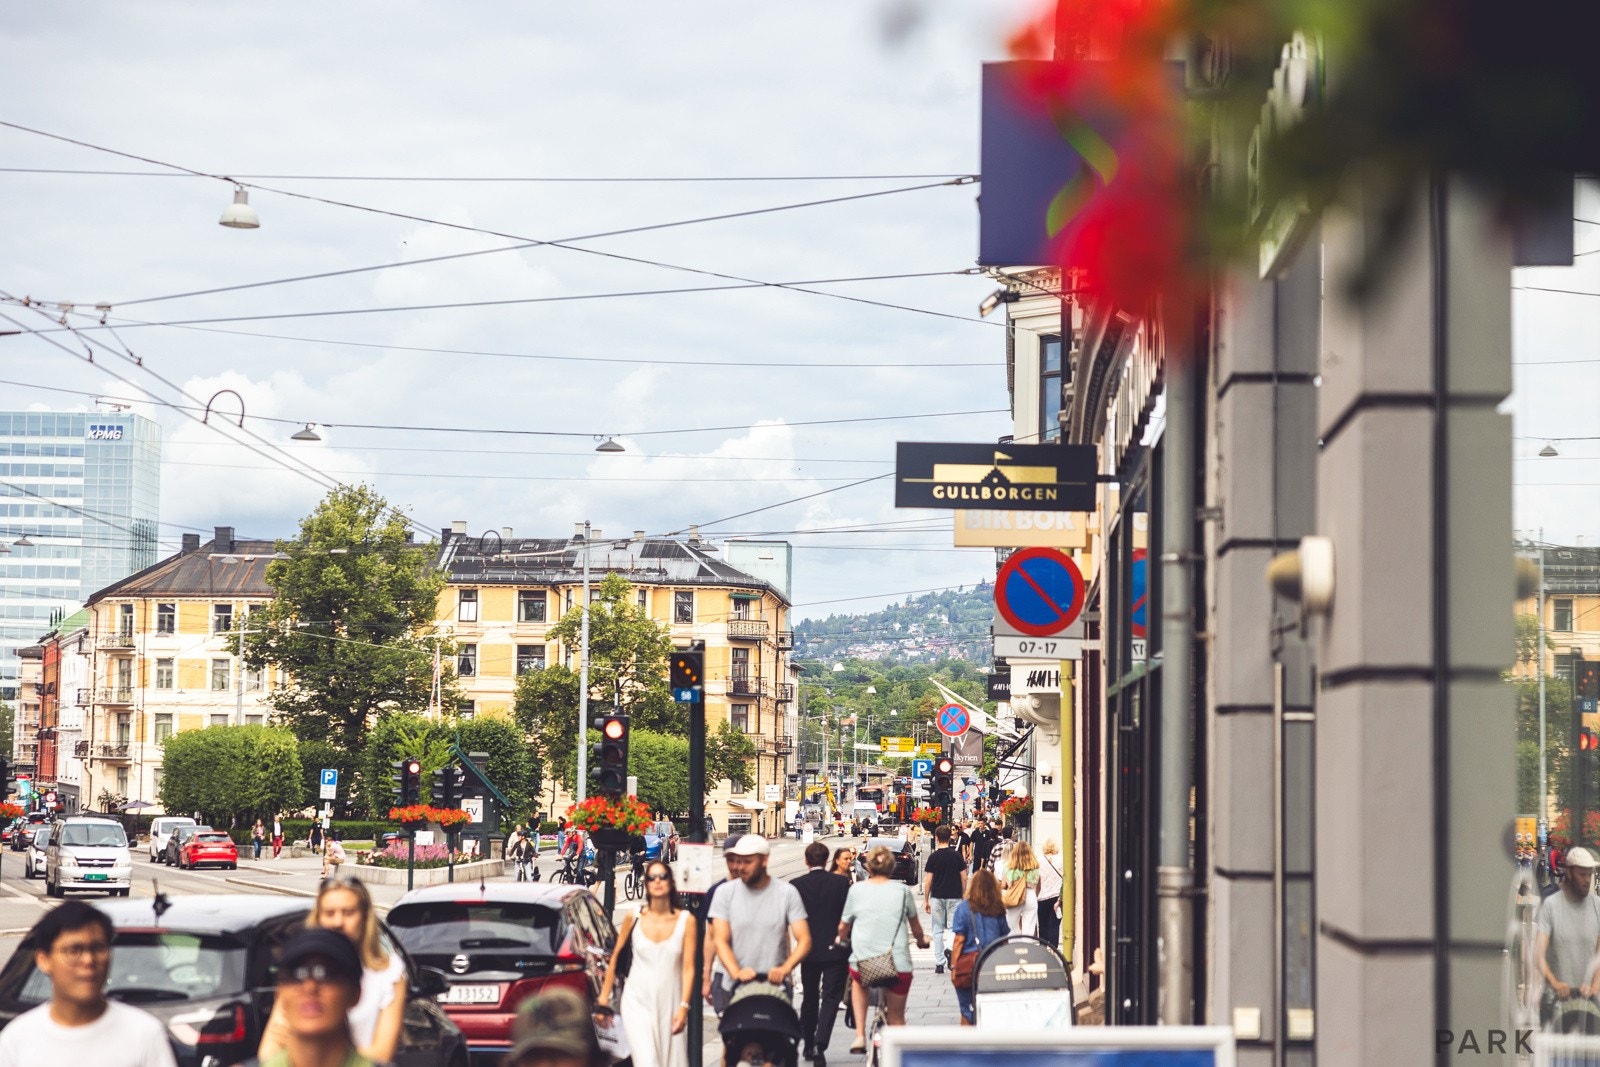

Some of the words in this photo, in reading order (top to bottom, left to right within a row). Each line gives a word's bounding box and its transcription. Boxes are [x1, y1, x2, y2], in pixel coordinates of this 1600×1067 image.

[87, 430, 122, 440] KPMG
[932, 485, 1058, 500] GULLBORGEN
[965, 509, 1011, 530] BIK
[1015, 510, 1075, 530] BOK
[1019, 641, 1057, 654] 07-17
[954, 753, 978, 763] lkyrien
[916, 761, 928, 777] P
[324, 771, 334, 784] P
[1435, 1029, 1535, 1054] PARK
